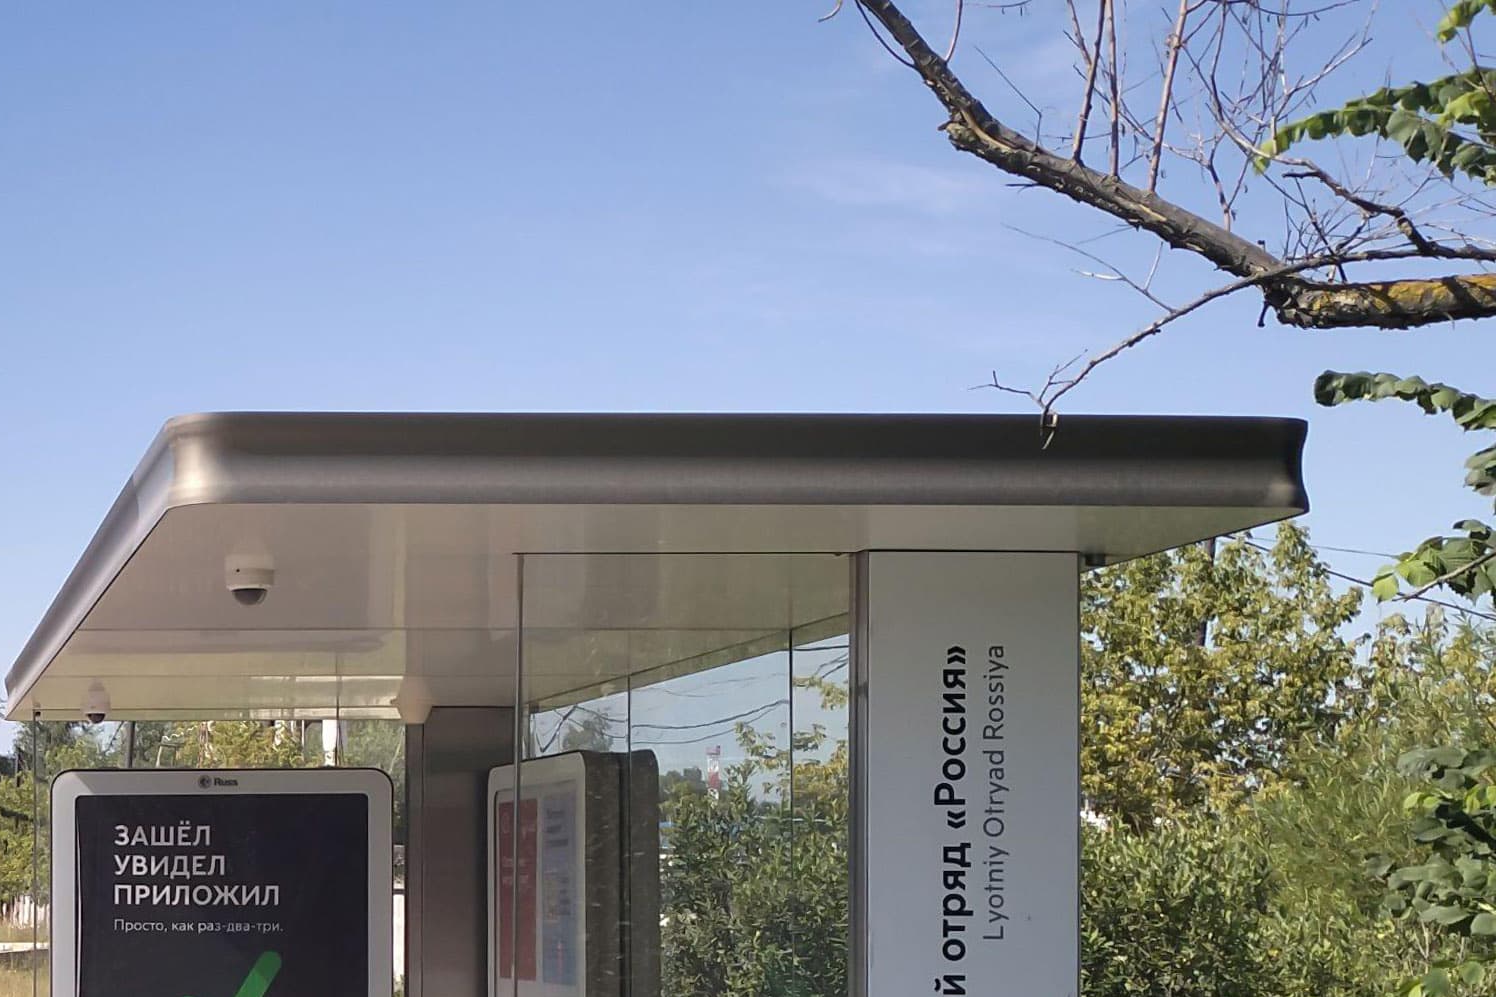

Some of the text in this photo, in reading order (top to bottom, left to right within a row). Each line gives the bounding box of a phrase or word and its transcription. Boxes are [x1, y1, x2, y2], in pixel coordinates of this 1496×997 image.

[933, 645, 967, 830] «Россия»
[982, 644, 1011, 941] Lyotniy Otryad Rossiya
[113, 819, 212, 847] ЗАШЁЛ
[113, 854, 226, 880] УВИДЕЛ
[113, 884, 280, 906] ПРИЛОЖИЛ
[942, 842, 974, 962] отряд
[113, 918, 284, 934] Просто, как раз-два-три.
